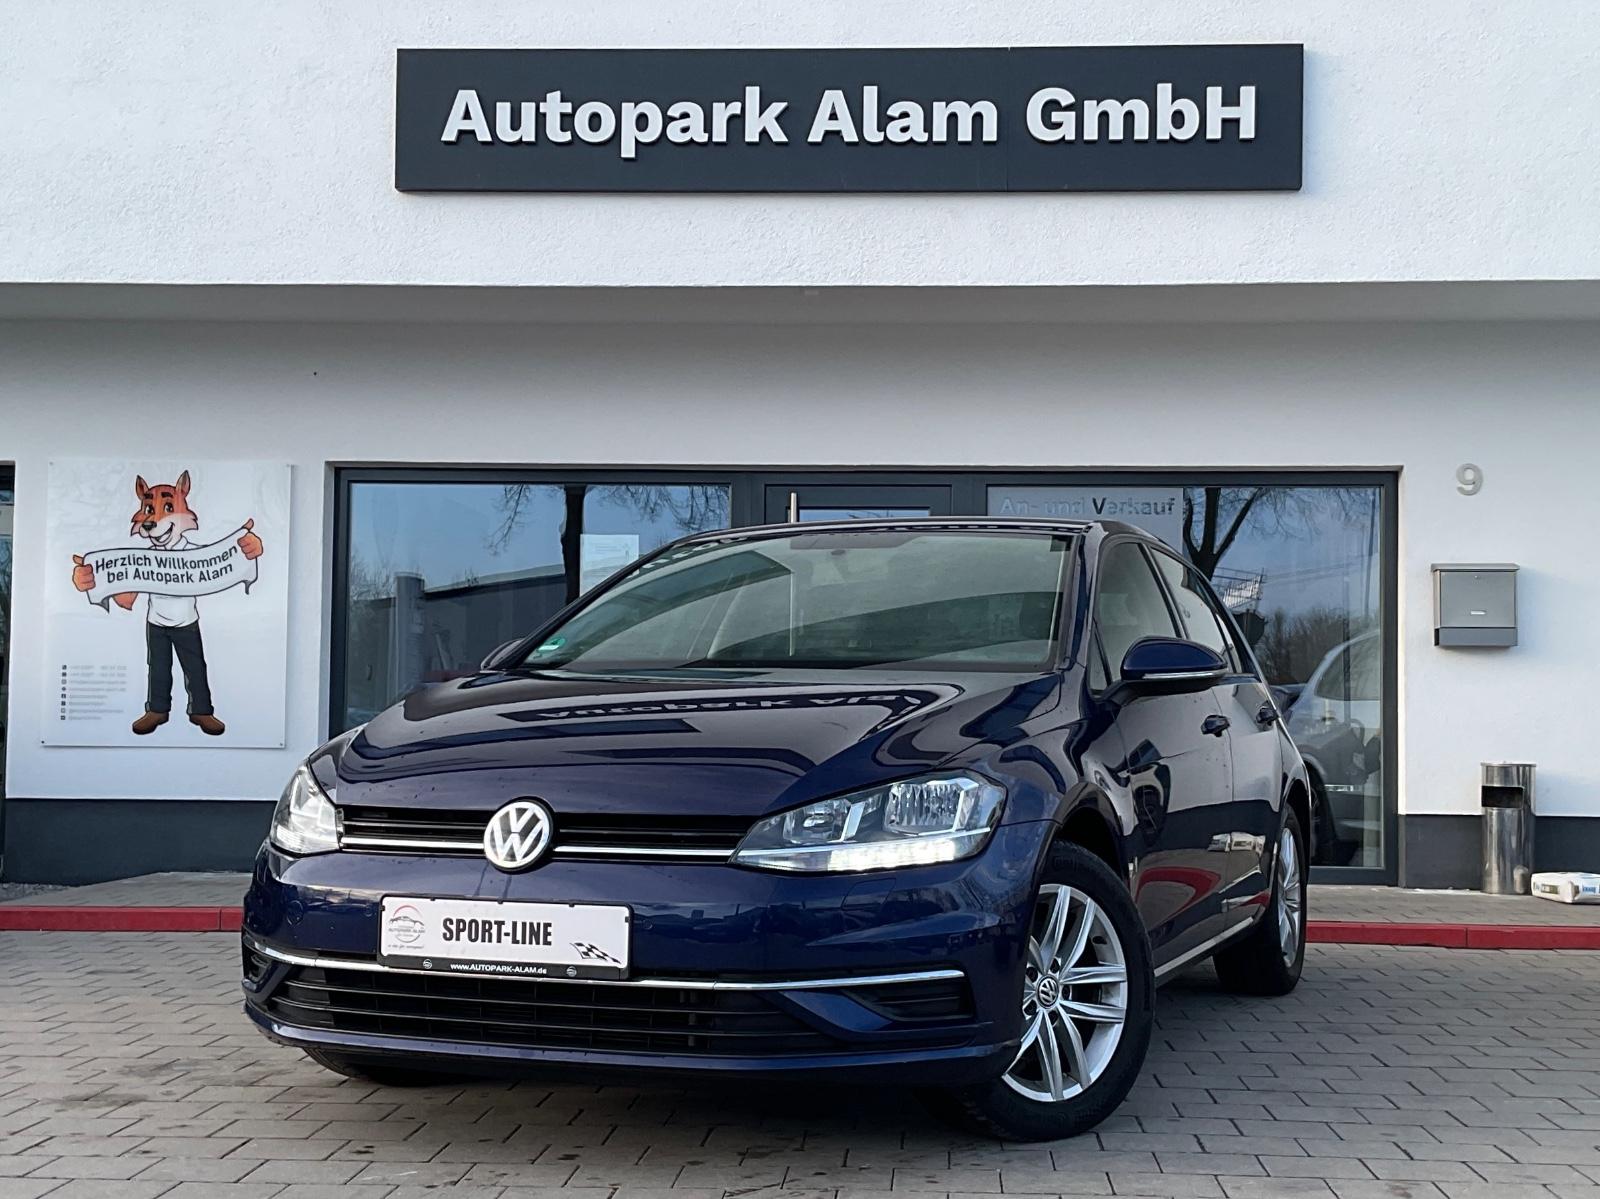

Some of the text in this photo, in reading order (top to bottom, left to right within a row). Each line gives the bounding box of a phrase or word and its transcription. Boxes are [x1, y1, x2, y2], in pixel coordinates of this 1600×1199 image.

[440, 83, 1257, 159] Autopark Alam GmbH
[1456, 463, 1483, 496] 9
[1045, 498, 1085, 515] und
[1092, 496, 1176, 516] Verkauf
[95, 544, 238, 574] Herzlich Willkommen
[107, 563, 233, 585] bei Autopark Alam
[442, 917, 552, 947] SPORT-LINE
[450, 962, 548, 975] www.AUTOPARK-ALAM.de
